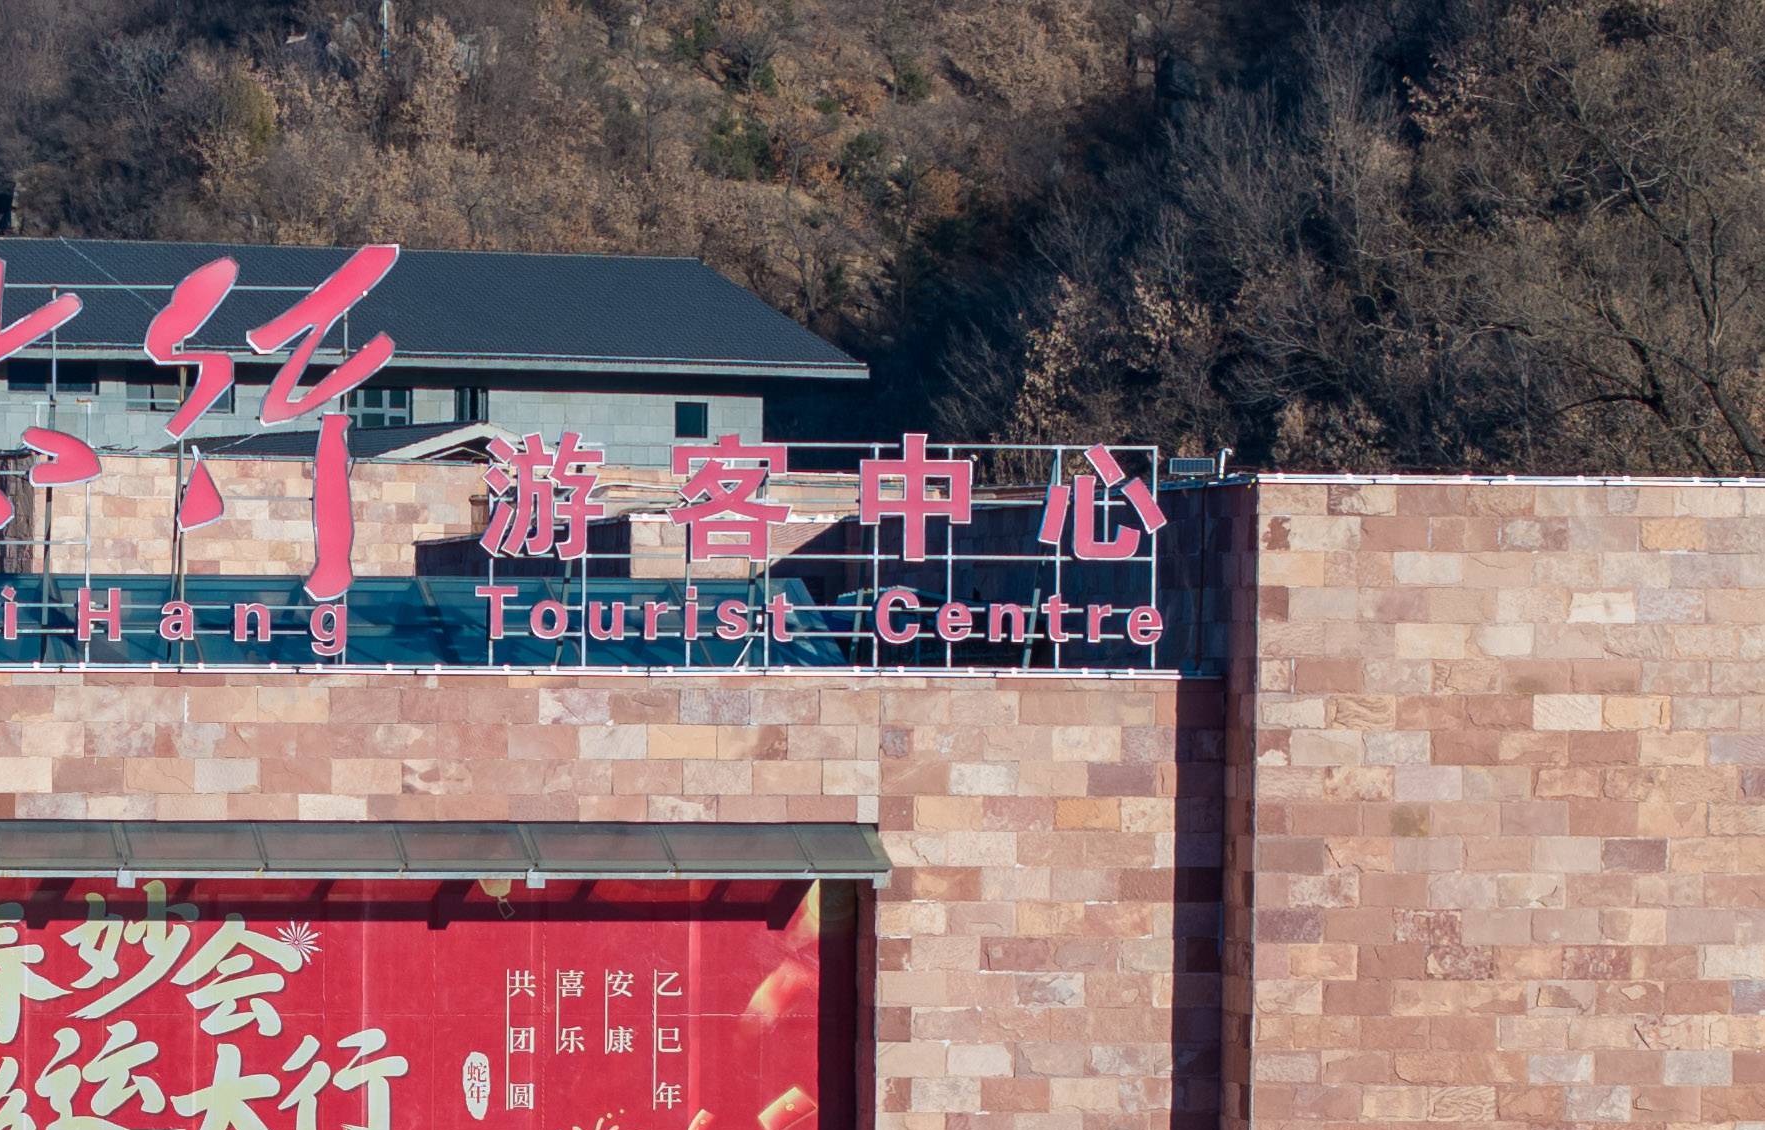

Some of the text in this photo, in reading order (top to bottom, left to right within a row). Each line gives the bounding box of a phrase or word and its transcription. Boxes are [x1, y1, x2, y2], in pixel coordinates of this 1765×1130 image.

[479, 431, 1168, 563] 游客中心
[475, 584, 1165, 646] Tourist Centre
[509, 970, 536, 1110] 共团圆
[558, 970, 585, 1053] 喜乐
[607, 970, 634, 1053] 安康
[655, 971, 683, 1109] 乙巳年
[466, 1062, 488, 1105] 蛇年
